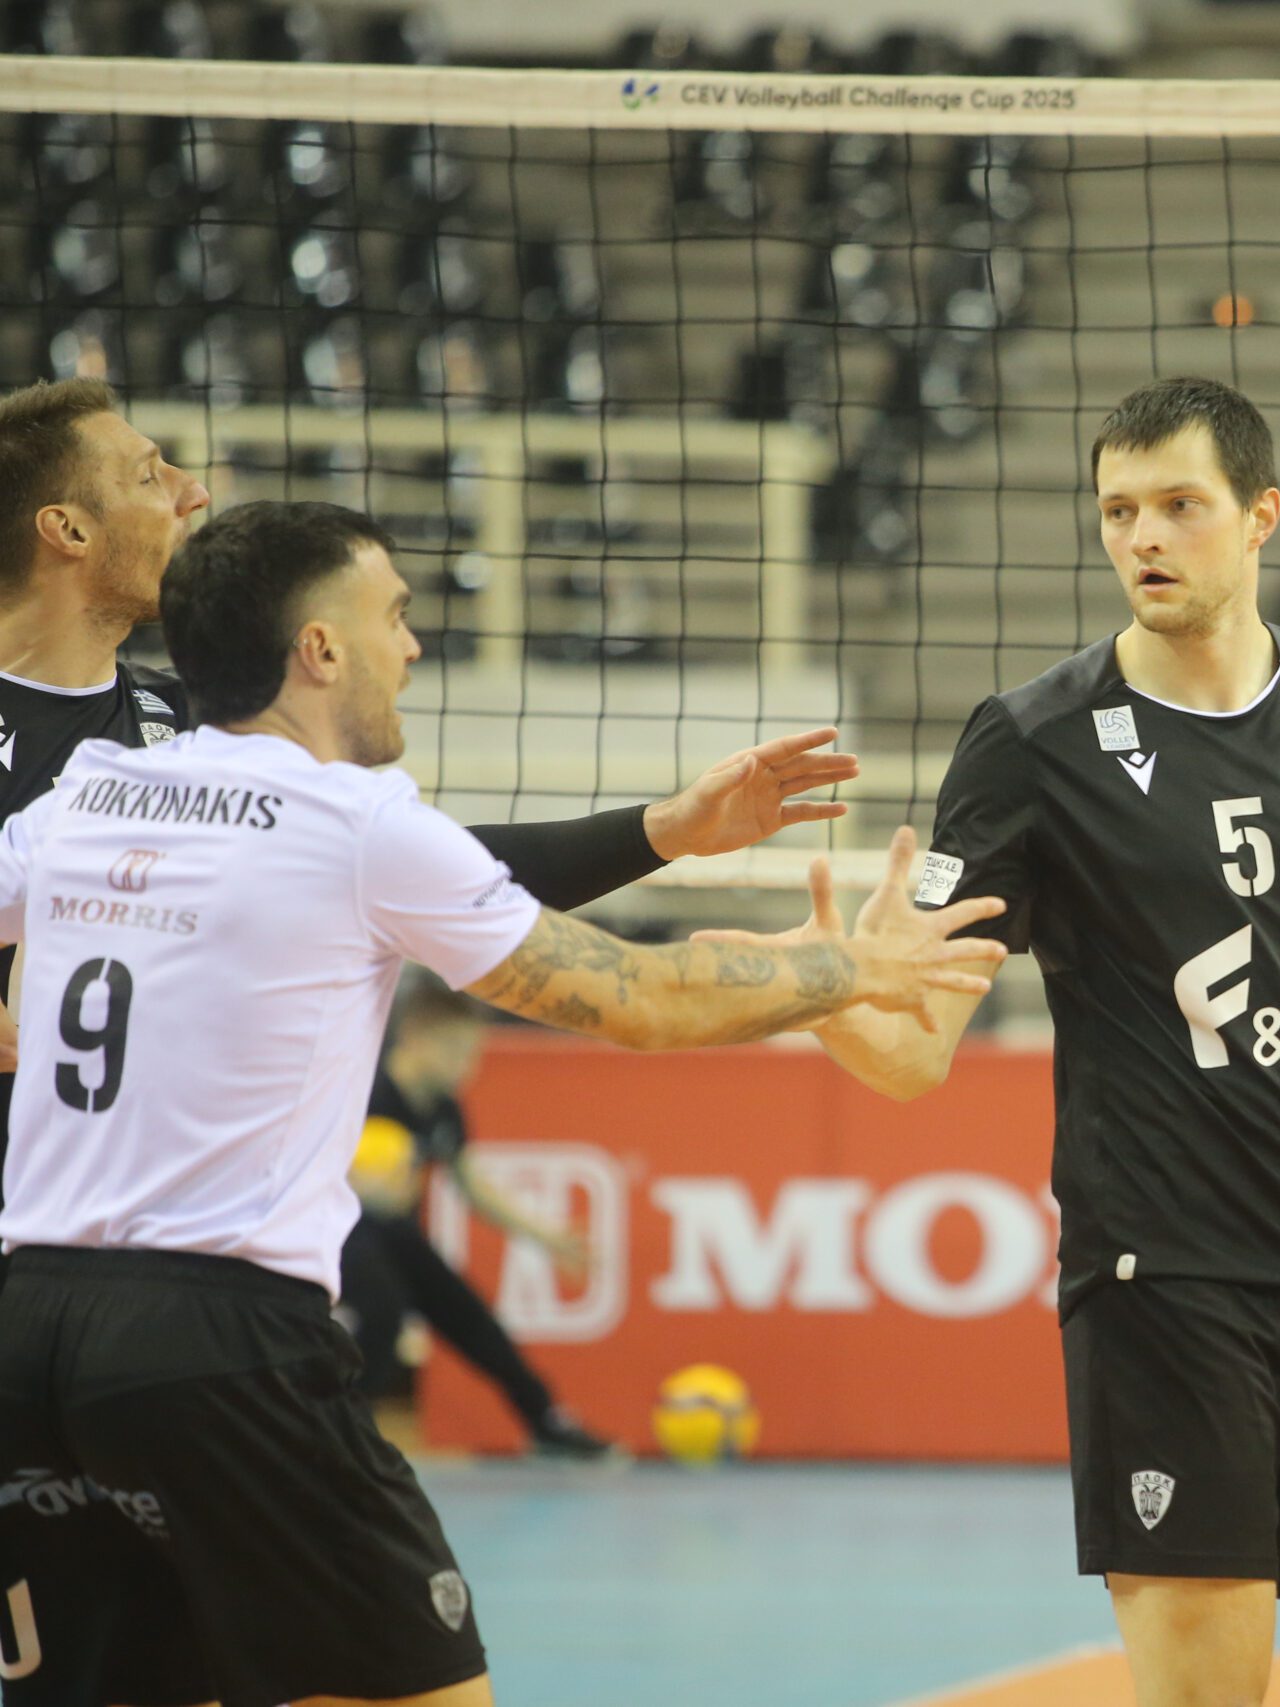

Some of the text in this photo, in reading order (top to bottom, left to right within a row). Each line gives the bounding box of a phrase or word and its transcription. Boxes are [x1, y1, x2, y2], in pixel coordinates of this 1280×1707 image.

[680, 83, 1077, 112] CEV Volleyball Challenge Cup 2025
[1101, 736, 1136, 744] VOLLEY
[68, 777, 283, 829] KOKKINAKIS
[1212, 796, 1276, 897] 5
[48, 896, 199, 936] MORRIS
[55, 957, 133, 1114] 9
